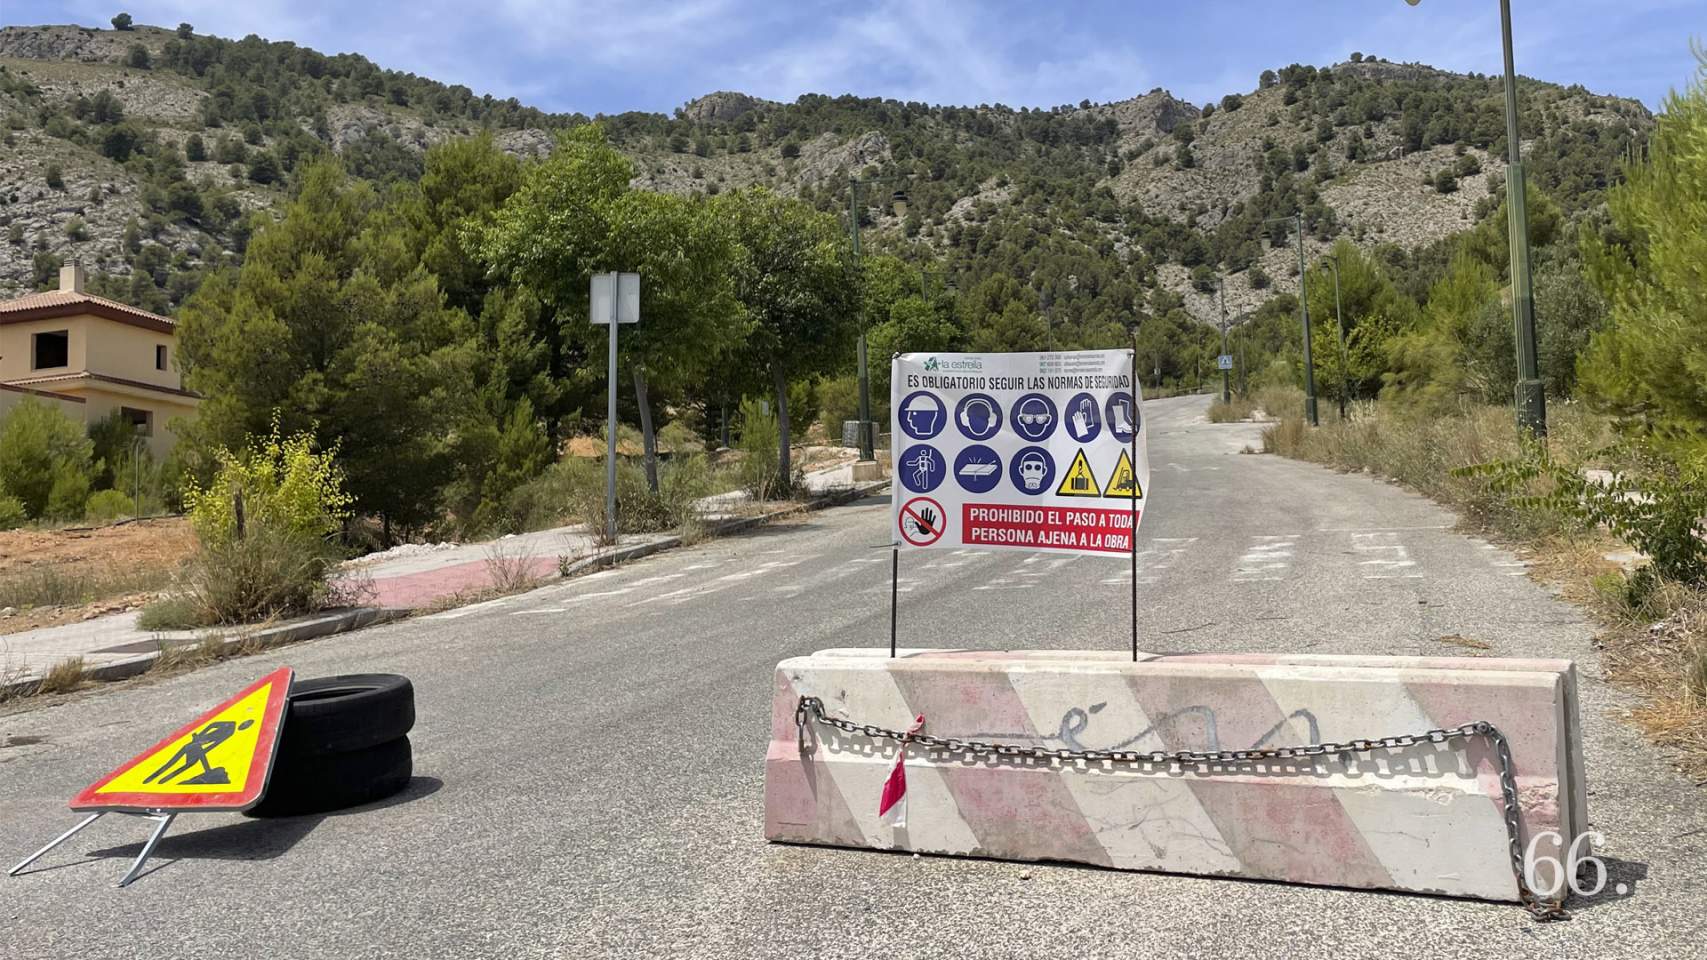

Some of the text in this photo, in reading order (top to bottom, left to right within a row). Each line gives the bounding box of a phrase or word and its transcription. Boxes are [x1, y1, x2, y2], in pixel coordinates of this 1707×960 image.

[907, 374, 1130, 390] ES OBLIGATORIO SEGUIR LAS NORMAS DE SEGURIDAD
[970, 507, 1134, 529] PROHIBIDO EL PASO A TODA
[971, 527, 1129, 549] PERSONA AJENA A LA OBRA
